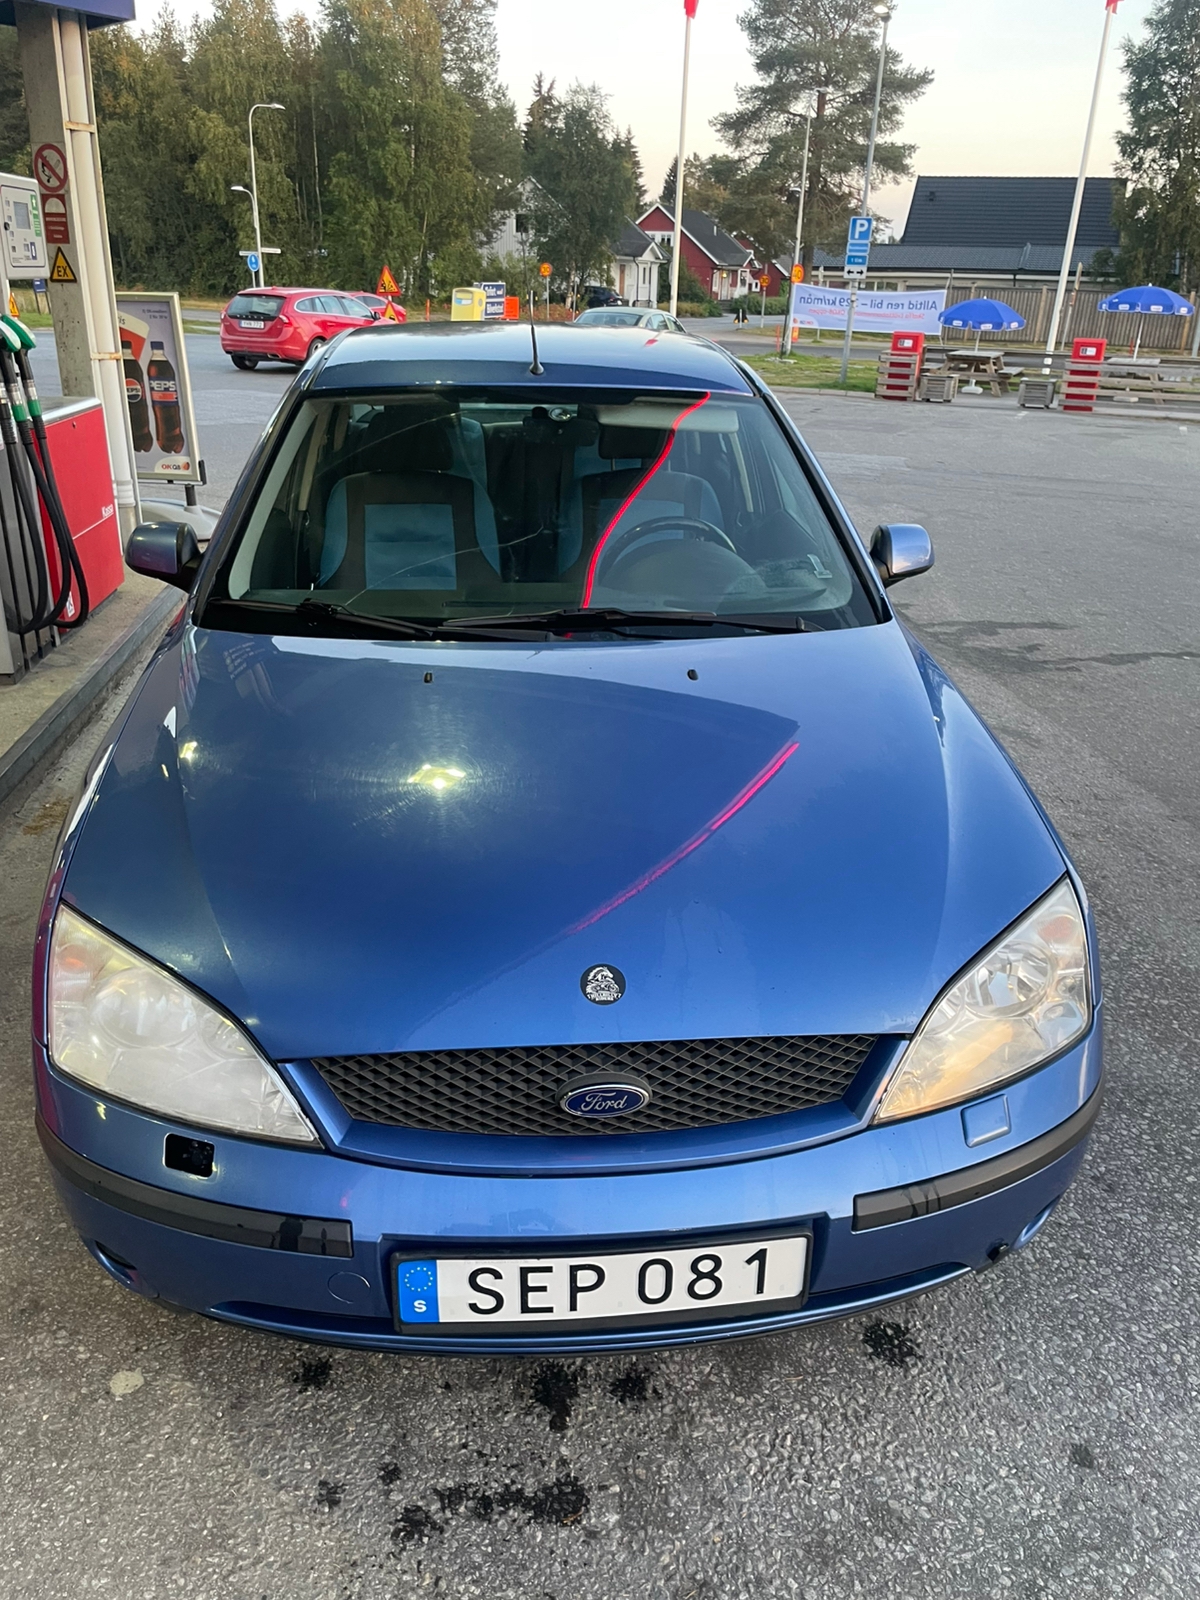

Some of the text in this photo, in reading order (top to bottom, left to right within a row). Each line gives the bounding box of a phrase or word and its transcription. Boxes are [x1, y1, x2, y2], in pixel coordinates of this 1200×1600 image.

[854, 219, 869, 239] P
[56, 265, 69, 277] EX
[580, 1091, 628, 1111] Ford
[467, 1247, 769, 1316] SEP 081
[413, 1300, 427, 1313] S
